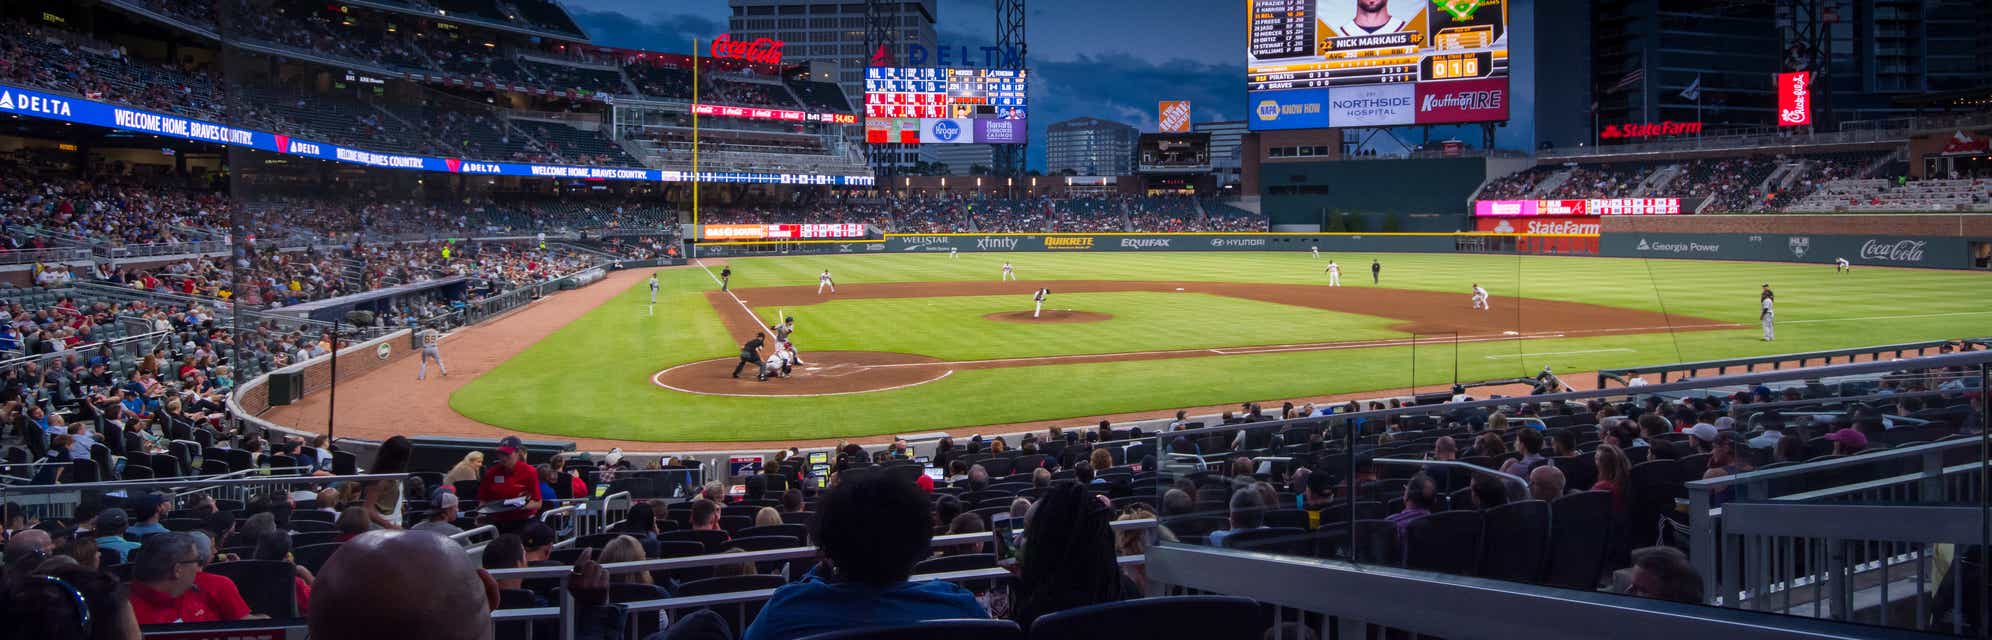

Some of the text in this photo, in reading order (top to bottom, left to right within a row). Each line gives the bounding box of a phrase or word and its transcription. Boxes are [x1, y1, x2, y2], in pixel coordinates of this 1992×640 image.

[1320, 34, 1423, 49] 22 NICK MARKAKIS RF
[909, 44, 1021, 67] DELTA
[1435, 63, 1445, 75] 0
[1466, 61, 1475, 73] 0
[869, 68, 881, 79] NL
[1269, 73, 1294, 81] PIRATES
[870, 93, 880, 104] AL
[1333, 96, 1411, 109] NORTHSIDE
[18, 93, 71, 117] DELTA
[1260, 105, 1277, 116] NAPA
[1282, 103, 1320, 115] KNOW HOW
[1347, 108, 1397, 117] HOSPITAL
[114, 108, 161, 132] WELCOME
[162, 117, 190, 138] HOME,
[190, 121, 220, 141] BRAVES
[935, 122, 958, 140] Kroger
[297, 142, 320, 155] DELTA
[389, 156, 424, 169] COUNTRY.
[470, 163, 501, 173] DELTA
[531, 165, 568, 176] WELCOME
[591, 168, 617, 178] BRAVES
[617, 169, 648, 179] COUNTRY.
[903, 236, 948, 245] WELLSTAR
[976, 236, 1018, 250] xfinity
[1044, 236, 1095, 246] QUIKRETE
[1120, 238, 1171, 249] EQUIFAX
[1652, 242, 1720, 253] Georgia Power
[1860, 239, 1927, 261] Coca-Cola
